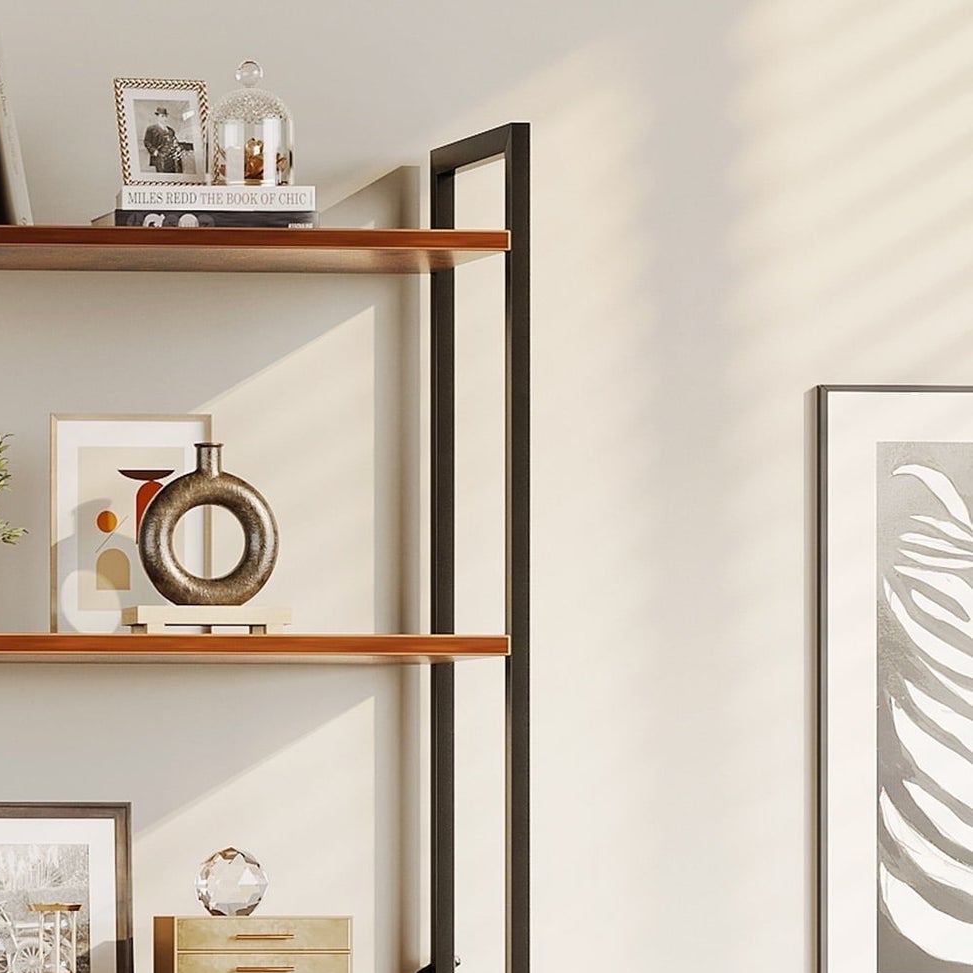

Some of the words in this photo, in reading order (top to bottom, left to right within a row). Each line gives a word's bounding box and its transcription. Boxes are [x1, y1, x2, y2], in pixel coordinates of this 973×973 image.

[128, 192, 163, 205] MILES
[166, 192, 198, 205] REDD
[200, 192, 224, 206] THE
[226, 192, 259, 206] BOOK
[260, 192, 277, 206] OF
[278, 192, 308, 206] CHIC
